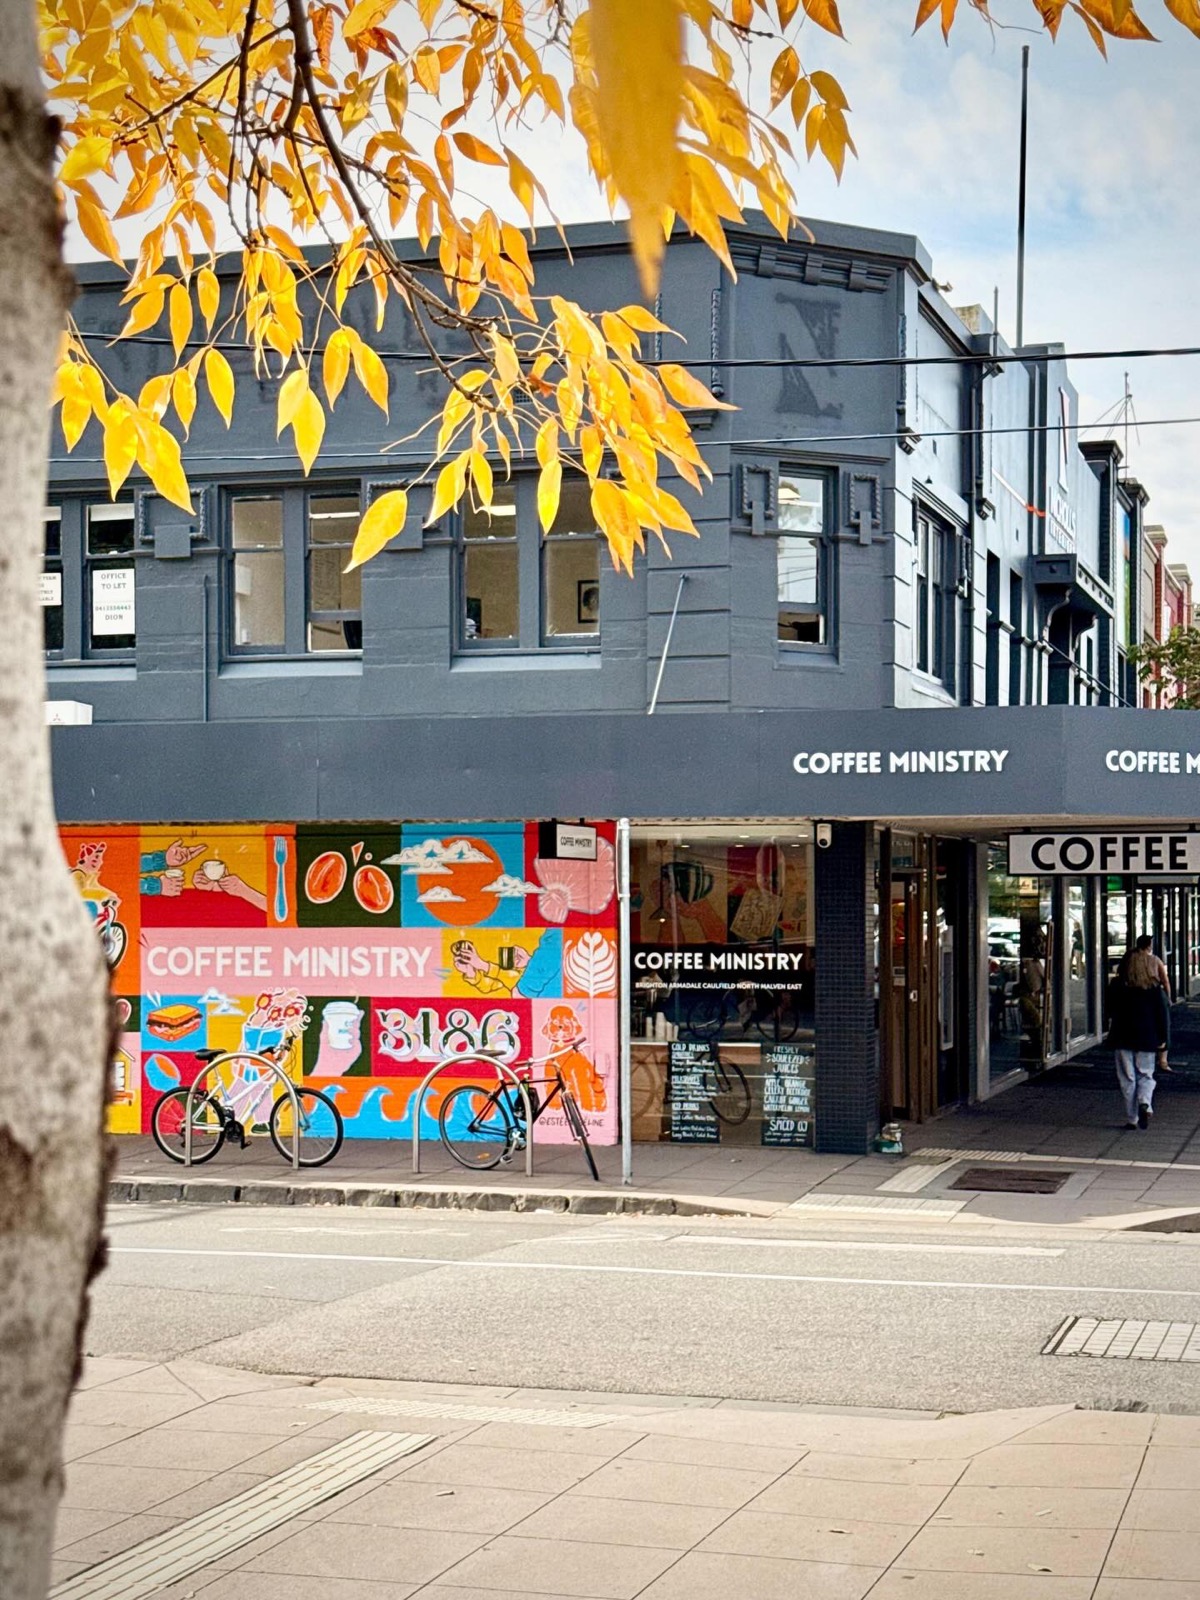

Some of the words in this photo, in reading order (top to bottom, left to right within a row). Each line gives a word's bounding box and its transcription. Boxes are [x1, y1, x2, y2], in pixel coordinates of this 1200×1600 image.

[793, 751, 882, 775] COFFEE
[889, 749, 1009, 774] MINISTRY
[1105, 750, 1181, 774] COFFEE
[1031, 836, 1188, 872] COFFEE
[147, 946, 273, 977] COFFEE
[283, 946, 433, 978] MINISTRY
[634, 952, 704, 970] COFFEE
[710, 952, 804, 971] MINISTRY
[635, 982, 668, 990] BRIGHTON
[668, 982, 702, 990] ARMADALE
[702, 982, 736, 990] CAULFIELD
[736, 982, 760, 990] NORTH
[787, 983, 803, 991] EAST
[374, 1007, 522, 1065] 3186
